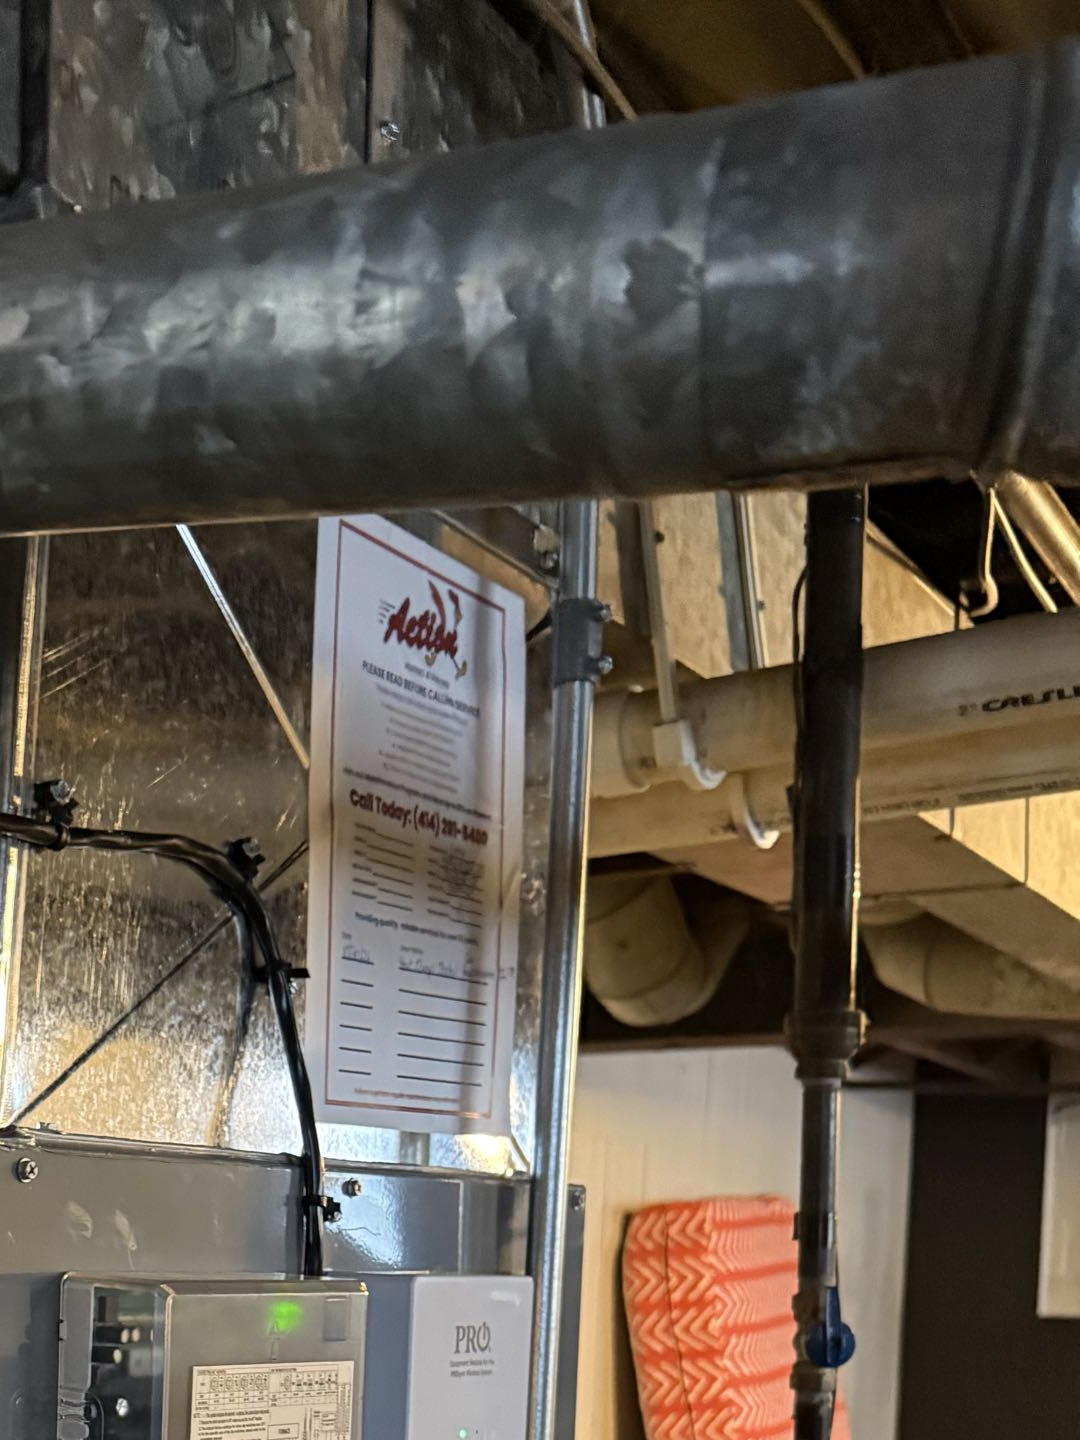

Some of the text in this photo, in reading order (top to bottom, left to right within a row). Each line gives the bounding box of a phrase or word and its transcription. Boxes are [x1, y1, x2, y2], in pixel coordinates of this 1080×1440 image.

[362, 660, 385, 680] PLEASE
[349, 787, 374, 812] Call
[454, 1321, 490, 1354] PRO
